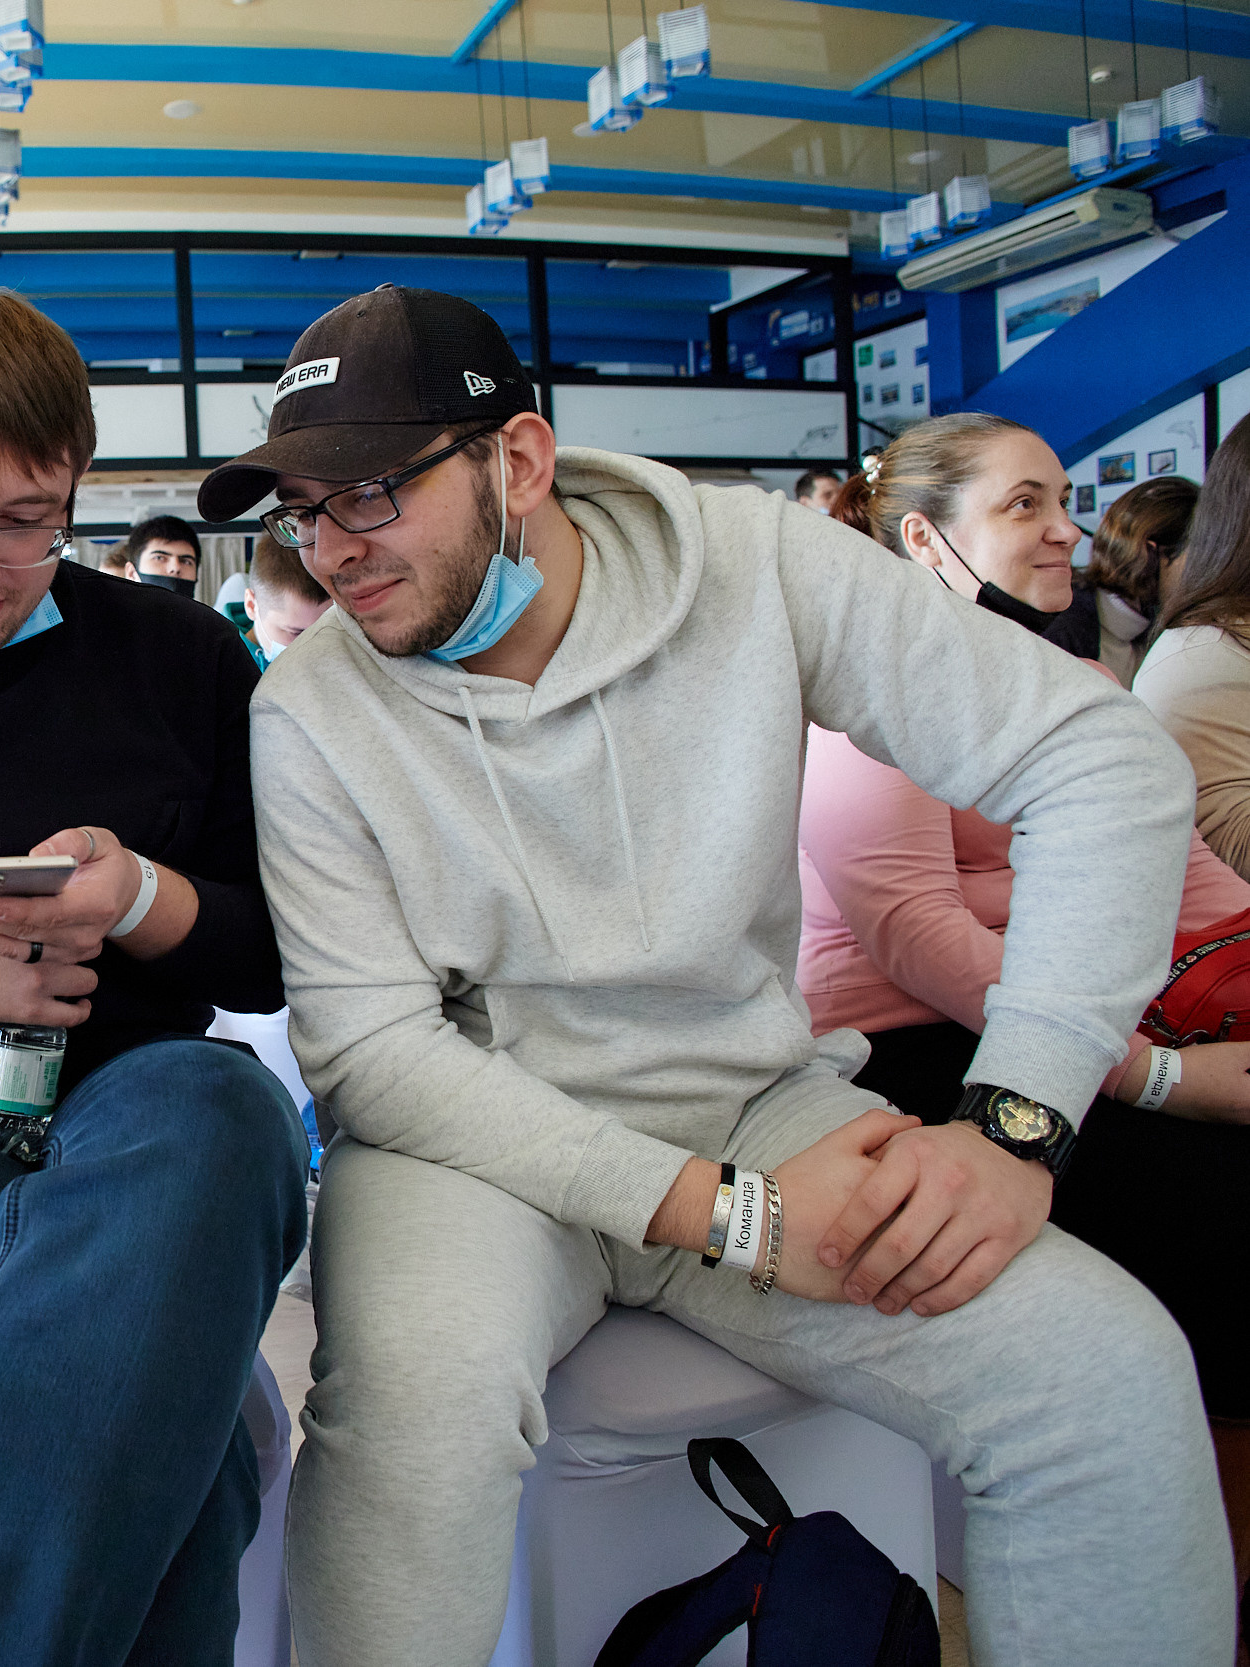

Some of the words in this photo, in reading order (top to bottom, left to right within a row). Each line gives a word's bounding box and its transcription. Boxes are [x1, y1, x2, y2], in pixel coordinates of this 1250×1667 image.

[276, 372, 296, 395] NEW
[298, 364, 329, 382] ERA
[144, 865, 155, 880] 15
[1150, 1049, 1172, 1097] Команда
[734, 1181, 757, 1250] Команда
